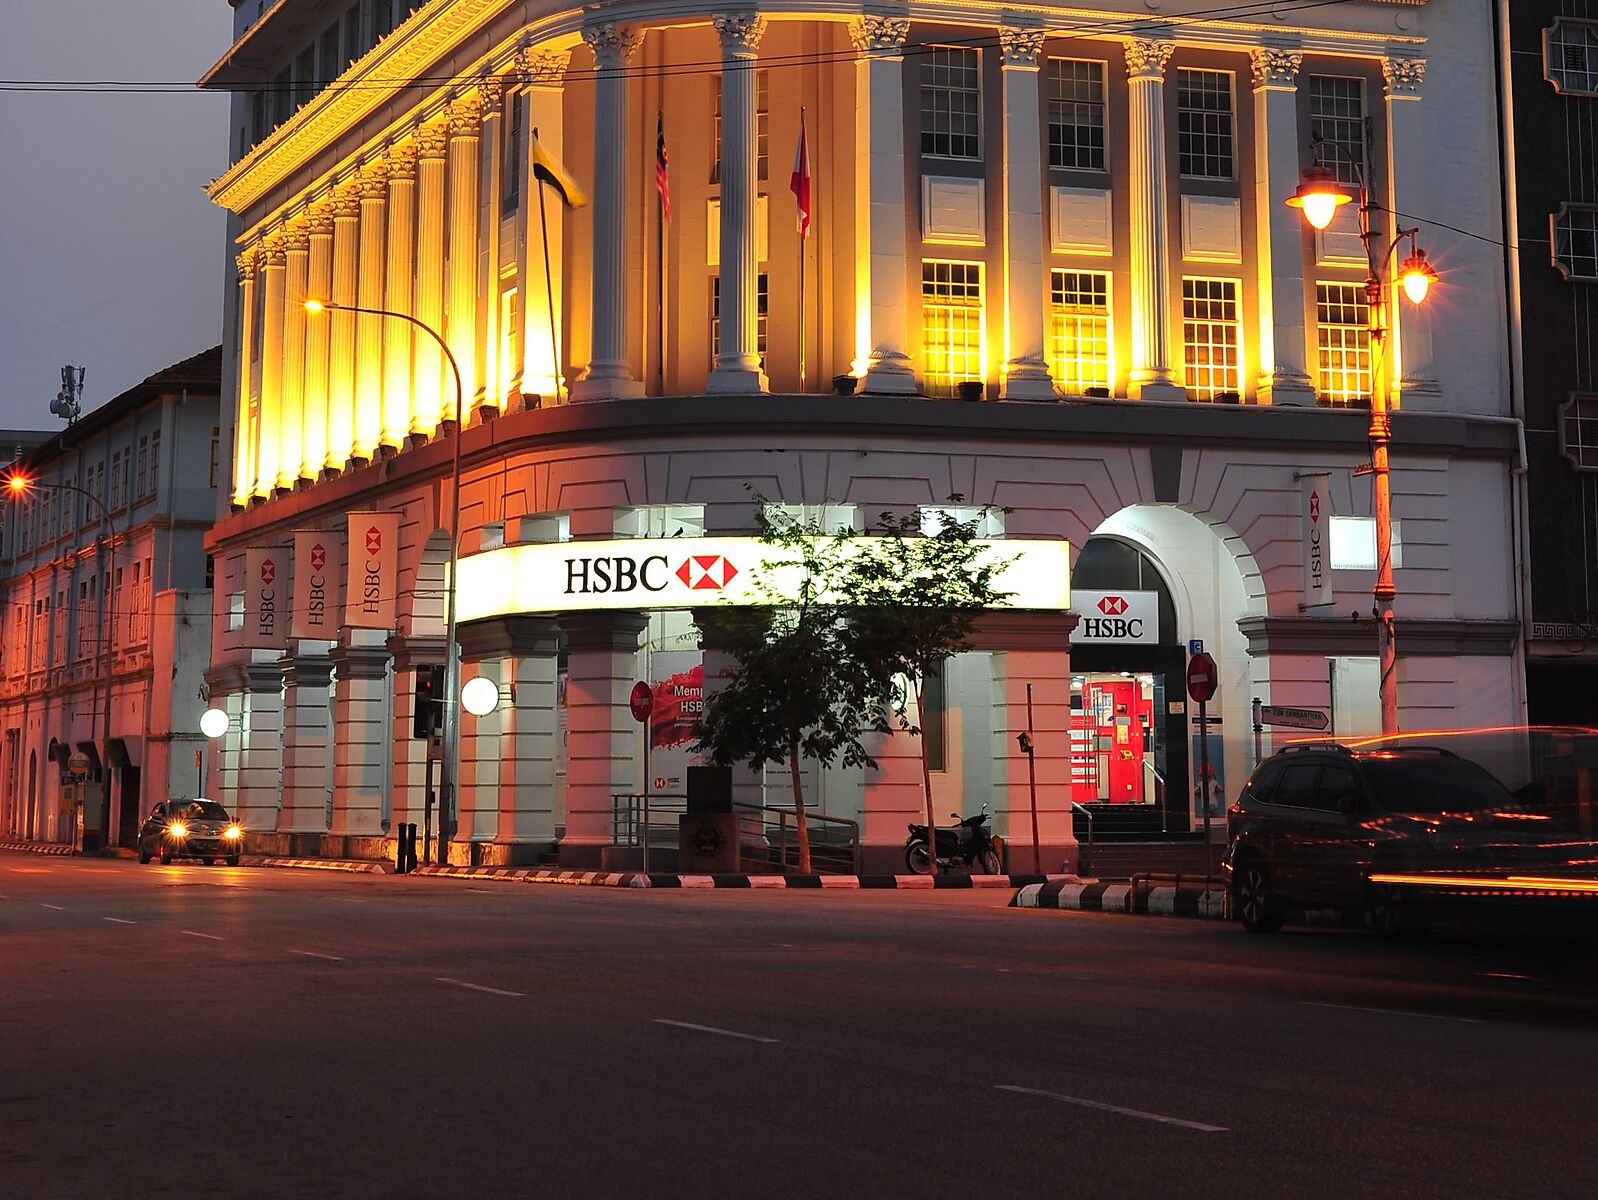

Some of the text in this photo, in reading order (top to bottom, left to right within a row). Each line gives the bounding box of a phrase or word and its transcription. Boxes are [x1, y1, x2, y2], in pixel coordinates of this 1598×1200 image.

[564, 555, 669, 594] HSBC
[1311, 529, 1322, 589] HSBC
[308, 575, 325, 626] HSBC
[362, 560, 381, 614] HSBC
[259, 589, 275, 636] HSBC
[1083, 618, 1143, 638] HSBC
